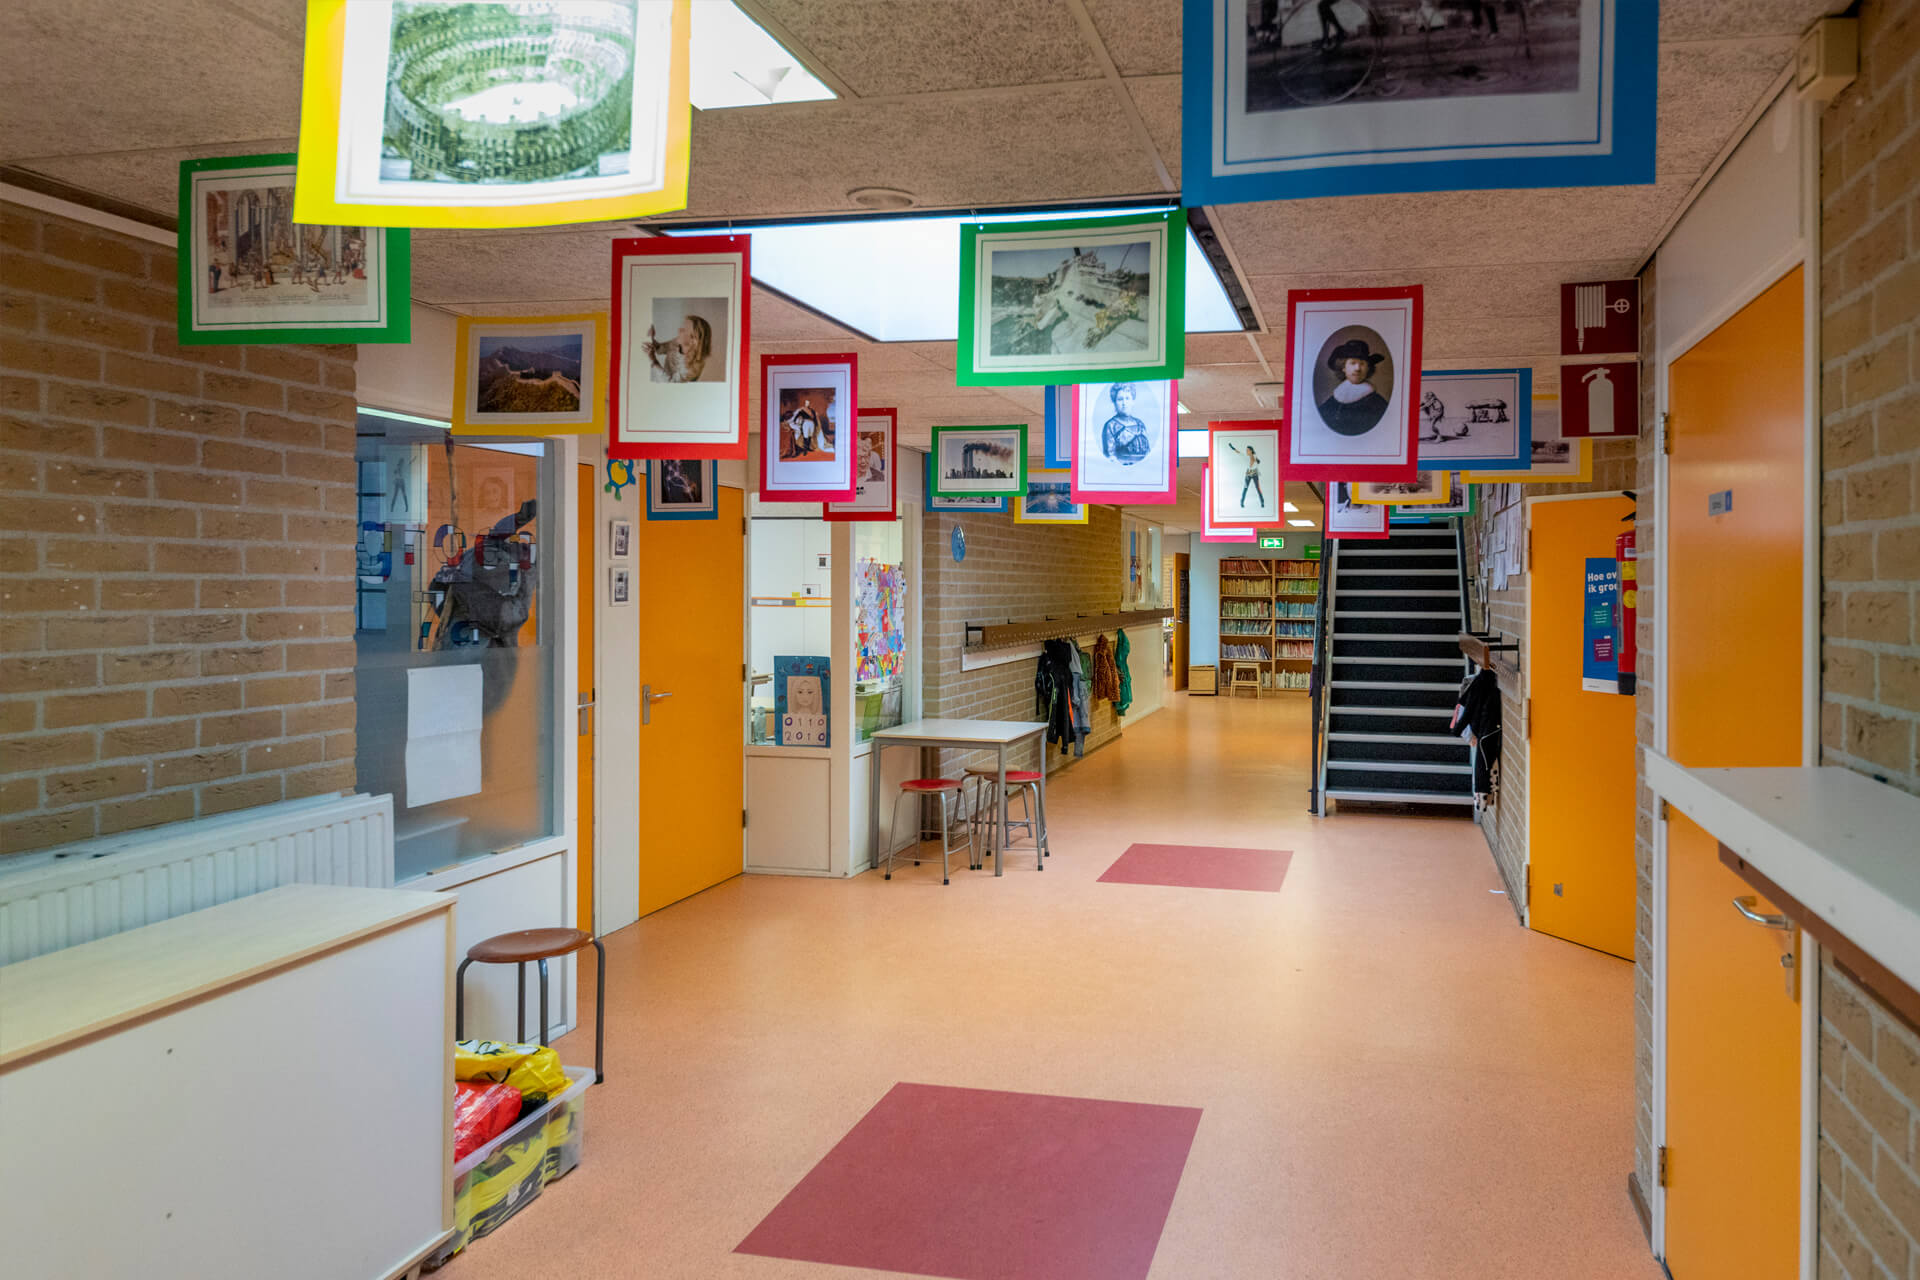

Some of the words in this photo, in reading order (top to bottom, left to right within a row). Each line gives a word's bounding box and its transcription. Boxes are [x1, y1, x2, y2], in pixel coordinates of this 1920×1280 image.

[1588, 573, 1604, 582] Hoe
[1588, 584, 1597, 593] ik
[785, 731, 826, 742] 2010
